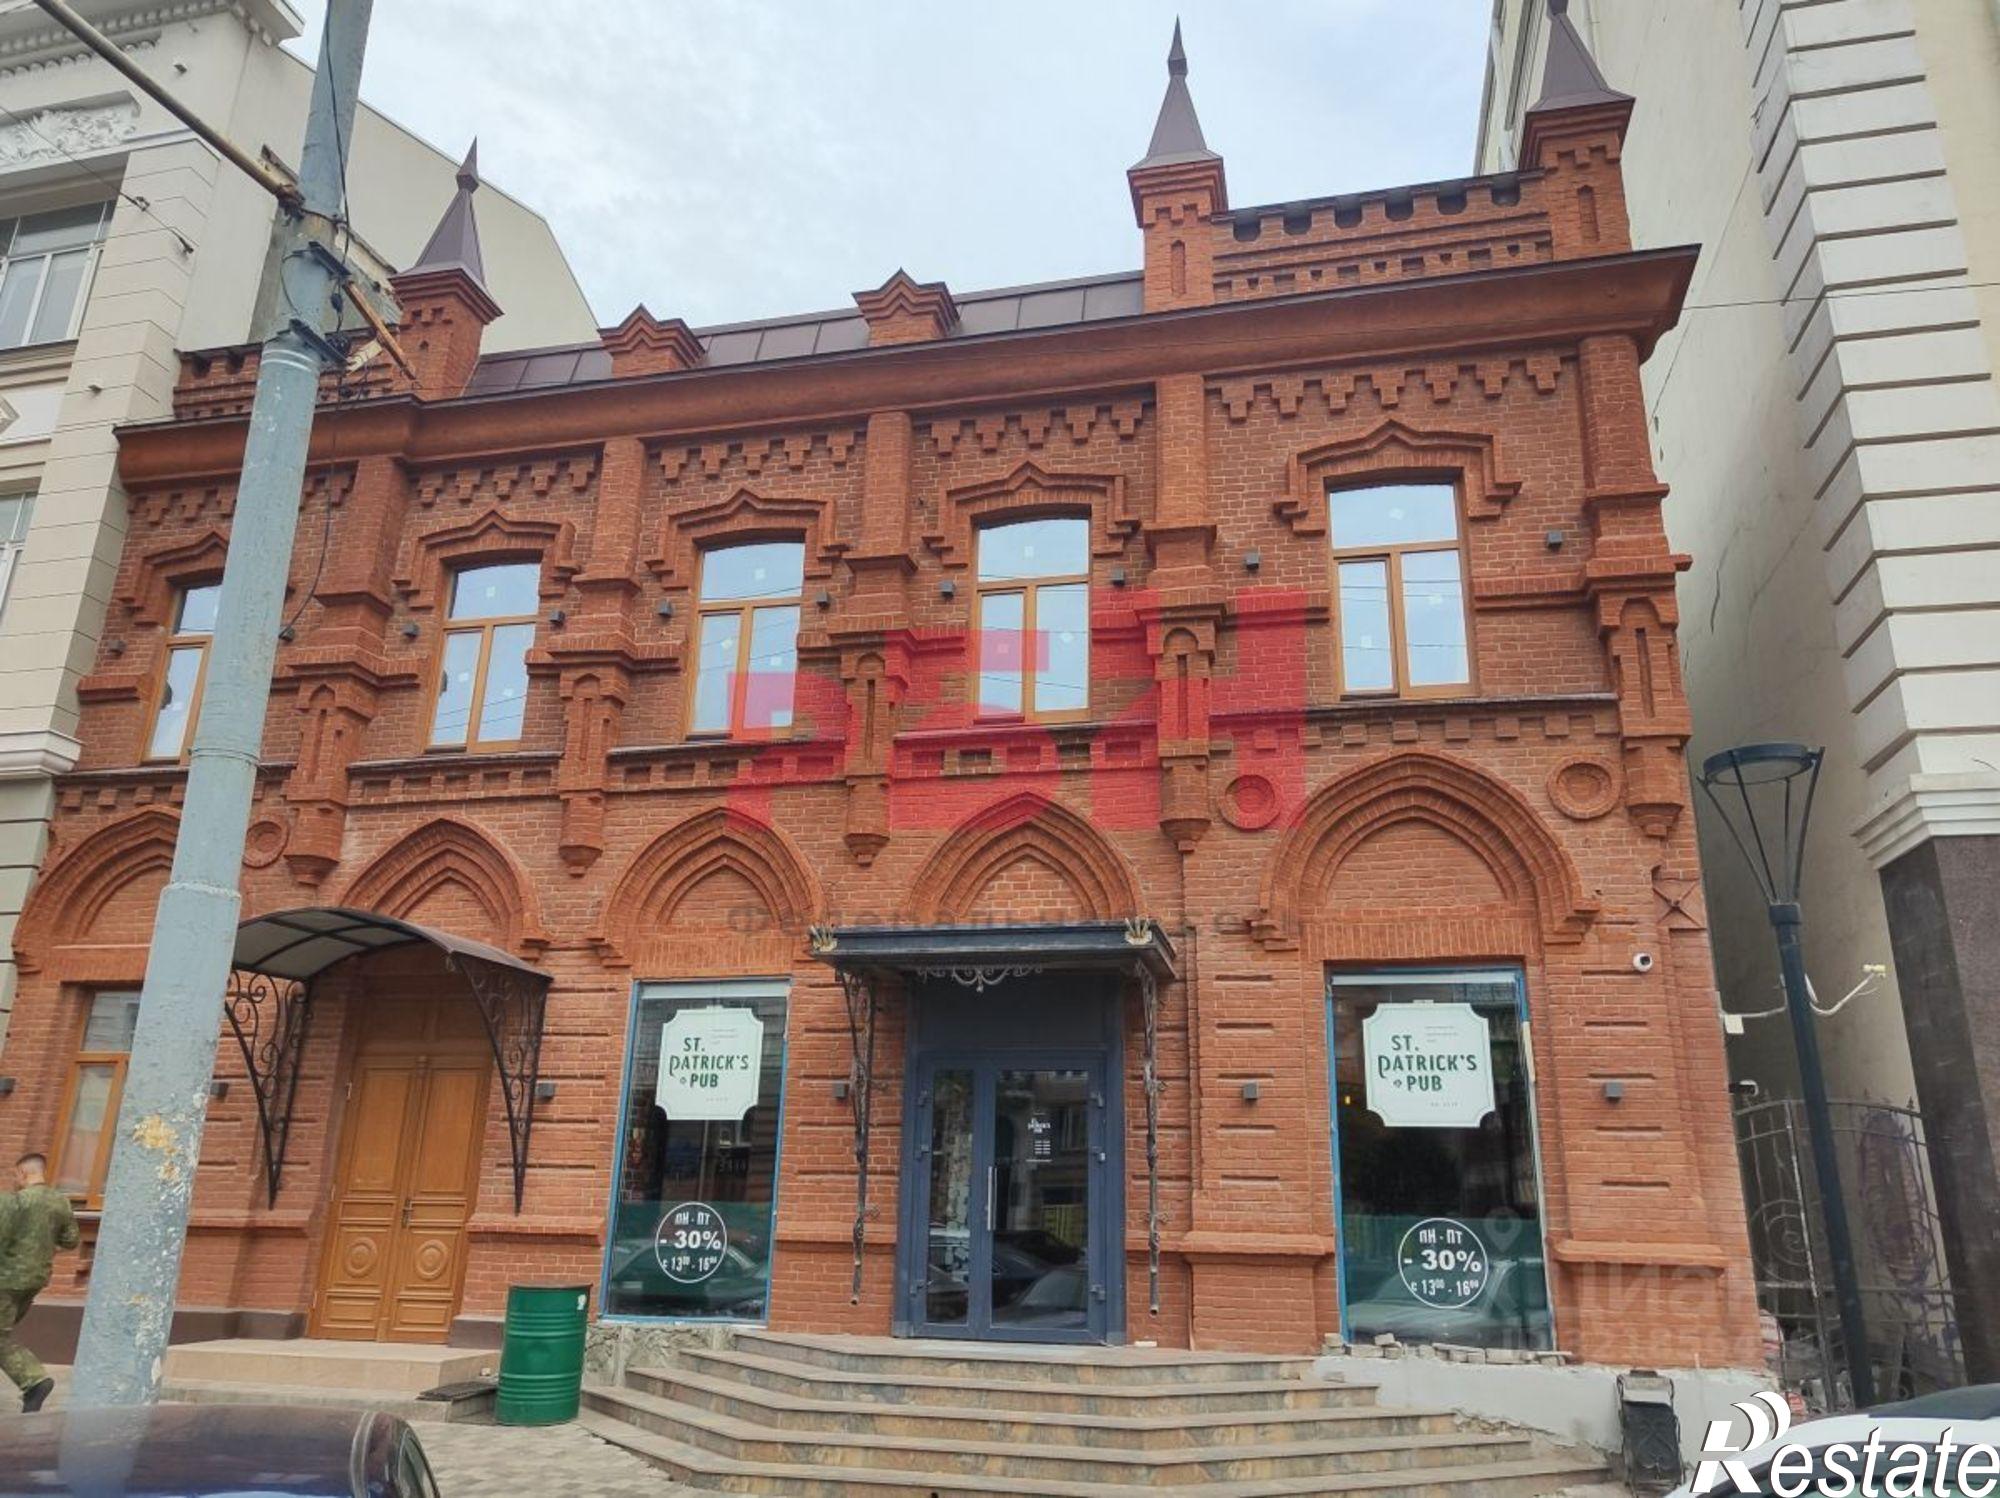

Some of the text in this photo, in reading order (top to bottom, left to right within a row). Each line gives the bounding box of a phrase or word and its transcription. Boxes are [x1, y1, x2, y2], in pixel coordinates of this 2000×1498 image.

[683, 1037, 705, 1052] ST.
[1391, 1035, 1419, 1051] ST.
[669, 1054, 749, 1077] PATRICK'S
[1377, 1054, 1478, 1079] PATRICK'S
[690, 1073, 719, 1088] PUB
[1406, 1075, 1443, 1091] PUB
[674, 1211, 690, 1225] ПН
[697, 1212, 711, 1225] ПТ
[674, 1230, 722, 1250] 30%
[1419, 1228, 1437, 1244] ПН
[1446, 1229, 1463, 1244] ПТ
[1421, 1249, 1482, 1272] 30%
